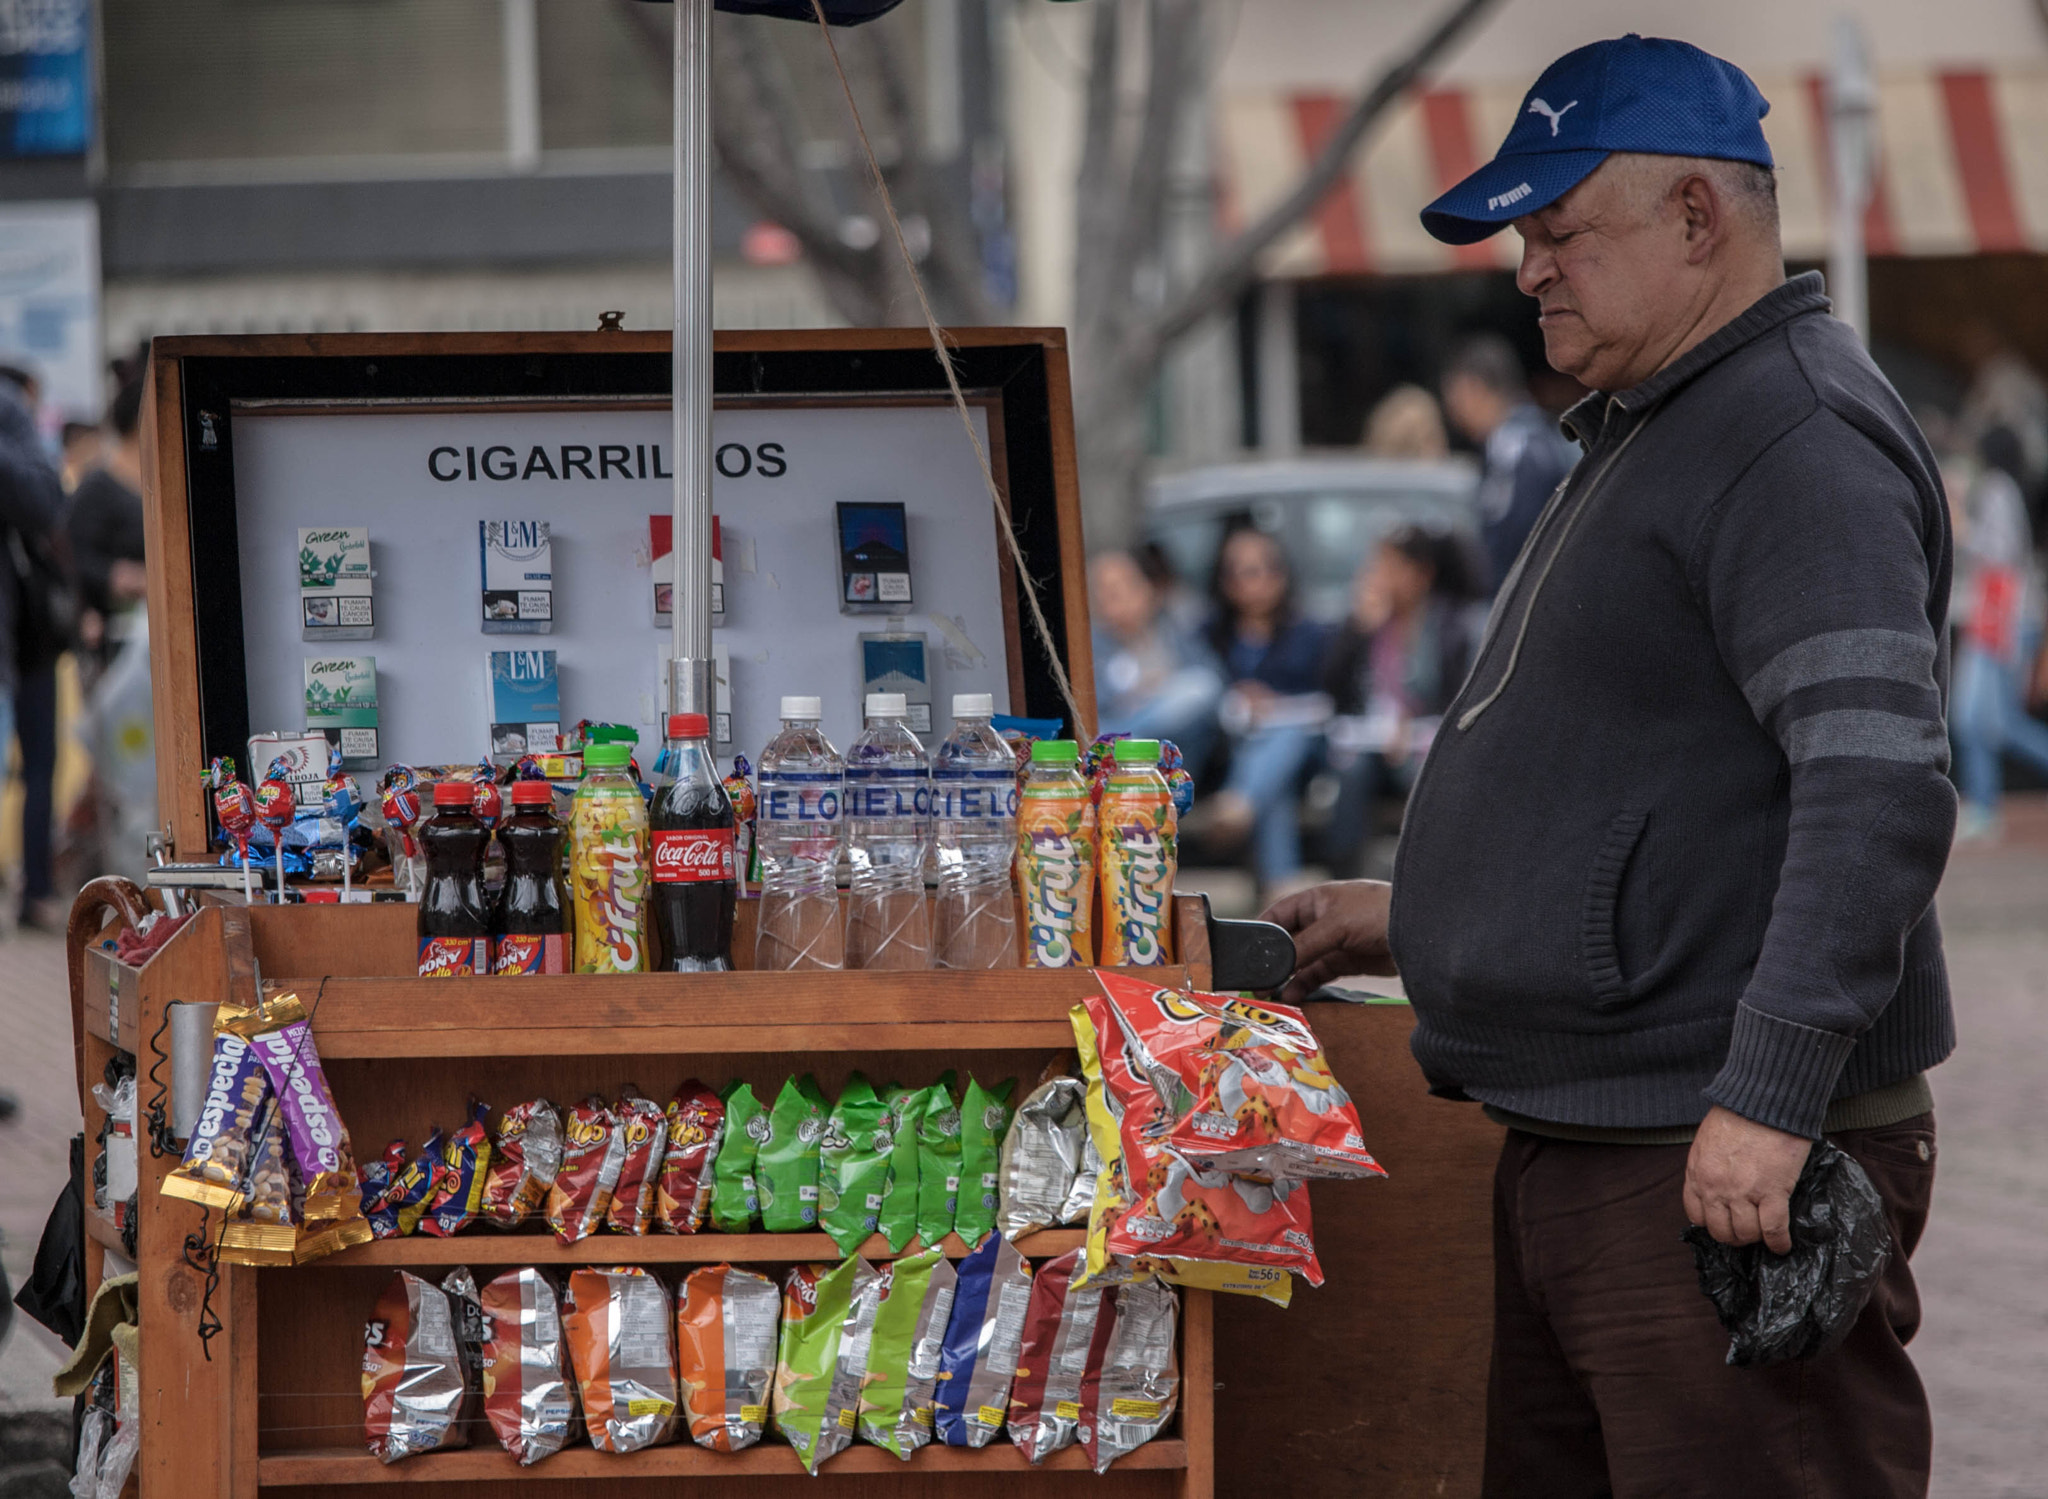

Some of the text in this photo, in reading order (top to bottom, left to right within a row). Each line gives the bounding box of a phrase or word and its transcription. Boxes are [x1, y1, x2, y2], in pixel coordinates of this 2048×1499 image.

[1488, 182, 1533, 211] PUMA
[428, 443, 788, 482] CIGARRILOS
[305, 530, 350, 544] Green
[503, 520, 537, 548] L&M
[311, 660, 356, 674] Green
[510, 651, 545, 680] L&M
[760, 790, 838, 820] IELO
[655, 840, 721, 867] Coca-Cola
[698, 869, 711, 877] 500
[711, 868, 719, 876] ml
[418, 949, 462, 977] PONY
[198, 1032, 248, 1138] especial
[252, 1031, 333, 1146] especial
[1297, 1233, 1310, 1247] 50
[1260, 1268, 1273, 1280] 56
